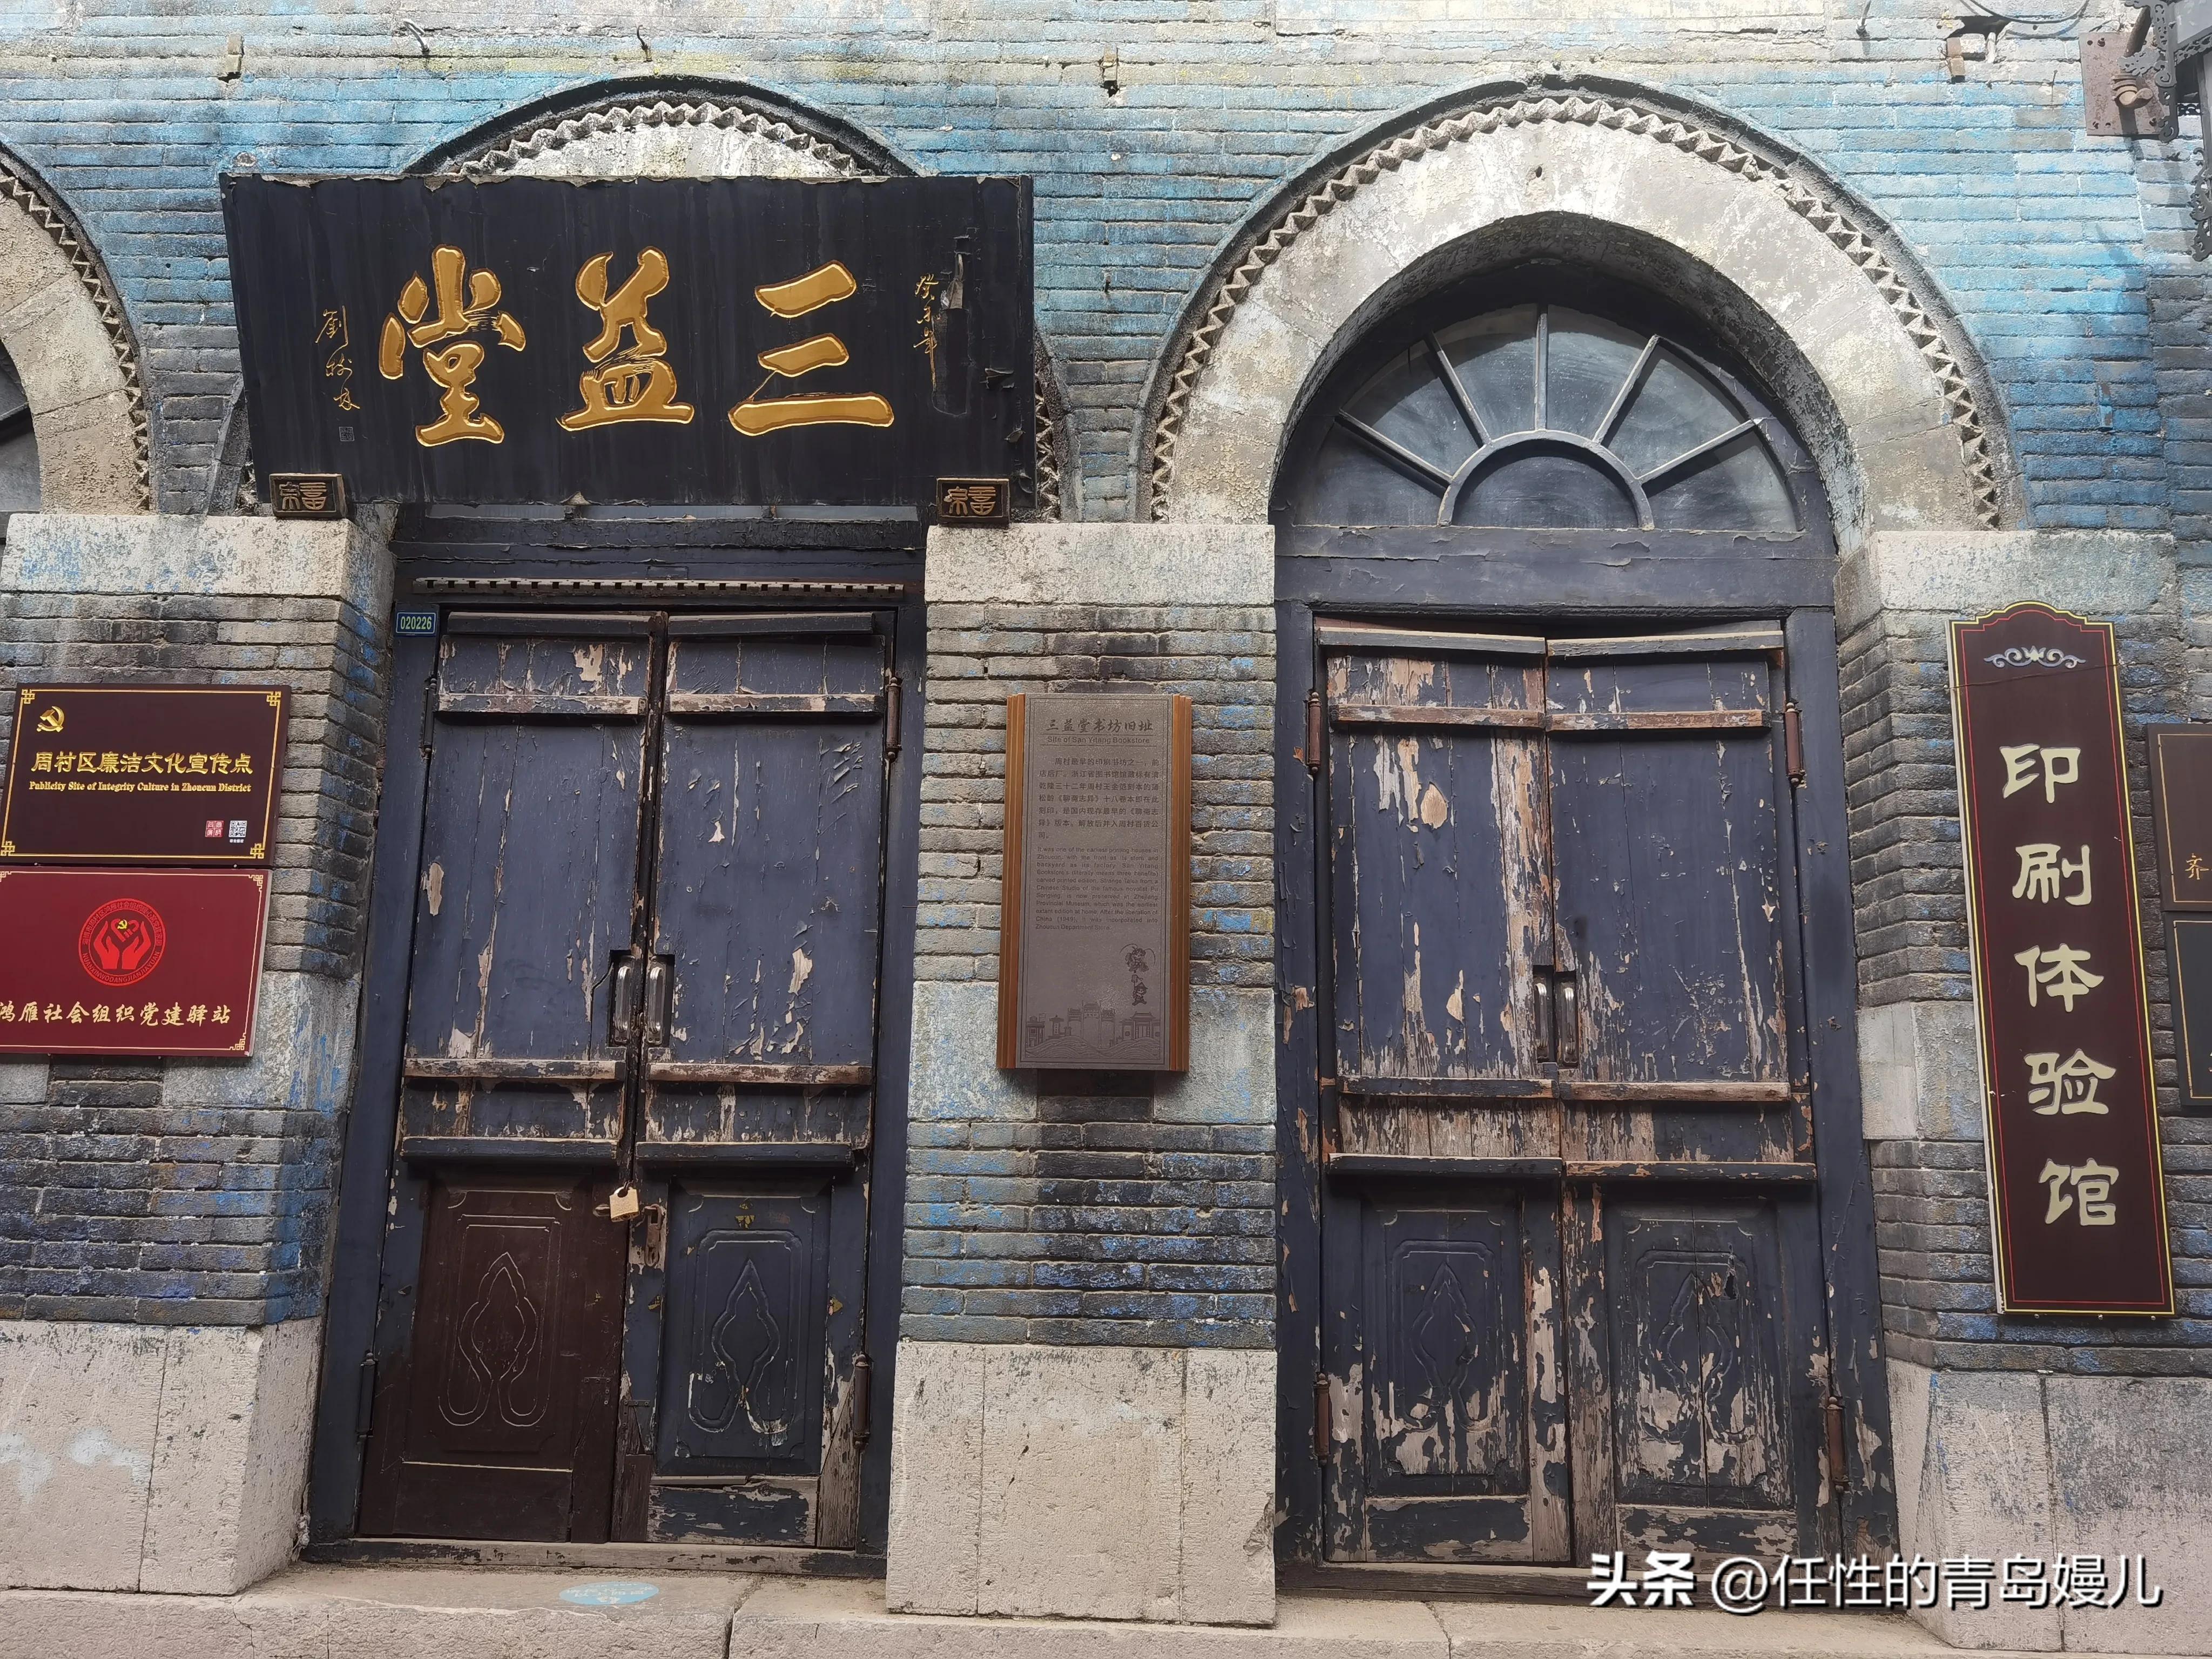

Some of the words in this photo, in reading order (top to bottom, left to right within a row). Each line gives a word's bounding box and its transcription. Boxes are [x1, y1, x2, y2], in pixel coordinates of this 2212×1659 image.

[401, 616, 432, 630] 020226
[1046, 718, 1153, 733] 三益堂书坊旧址
[31, 751, 254, 775] 周村区廉洁文化宣传点
[29, 781, 66, 791] Publicity
[68, 781, 85, 790] Site
[87, 781, 97, 790] of
[98, 781, 135, 792] Integrity
[137, 782, 168, 791] Culture
[171, 783, 179, 791] in
[218, 783, 252, 792] District
[1999, 744, 2119, 1225] 印刷体验馆
[0, 1001, 231, 1027] 鸿雁社会组织党建驿站
